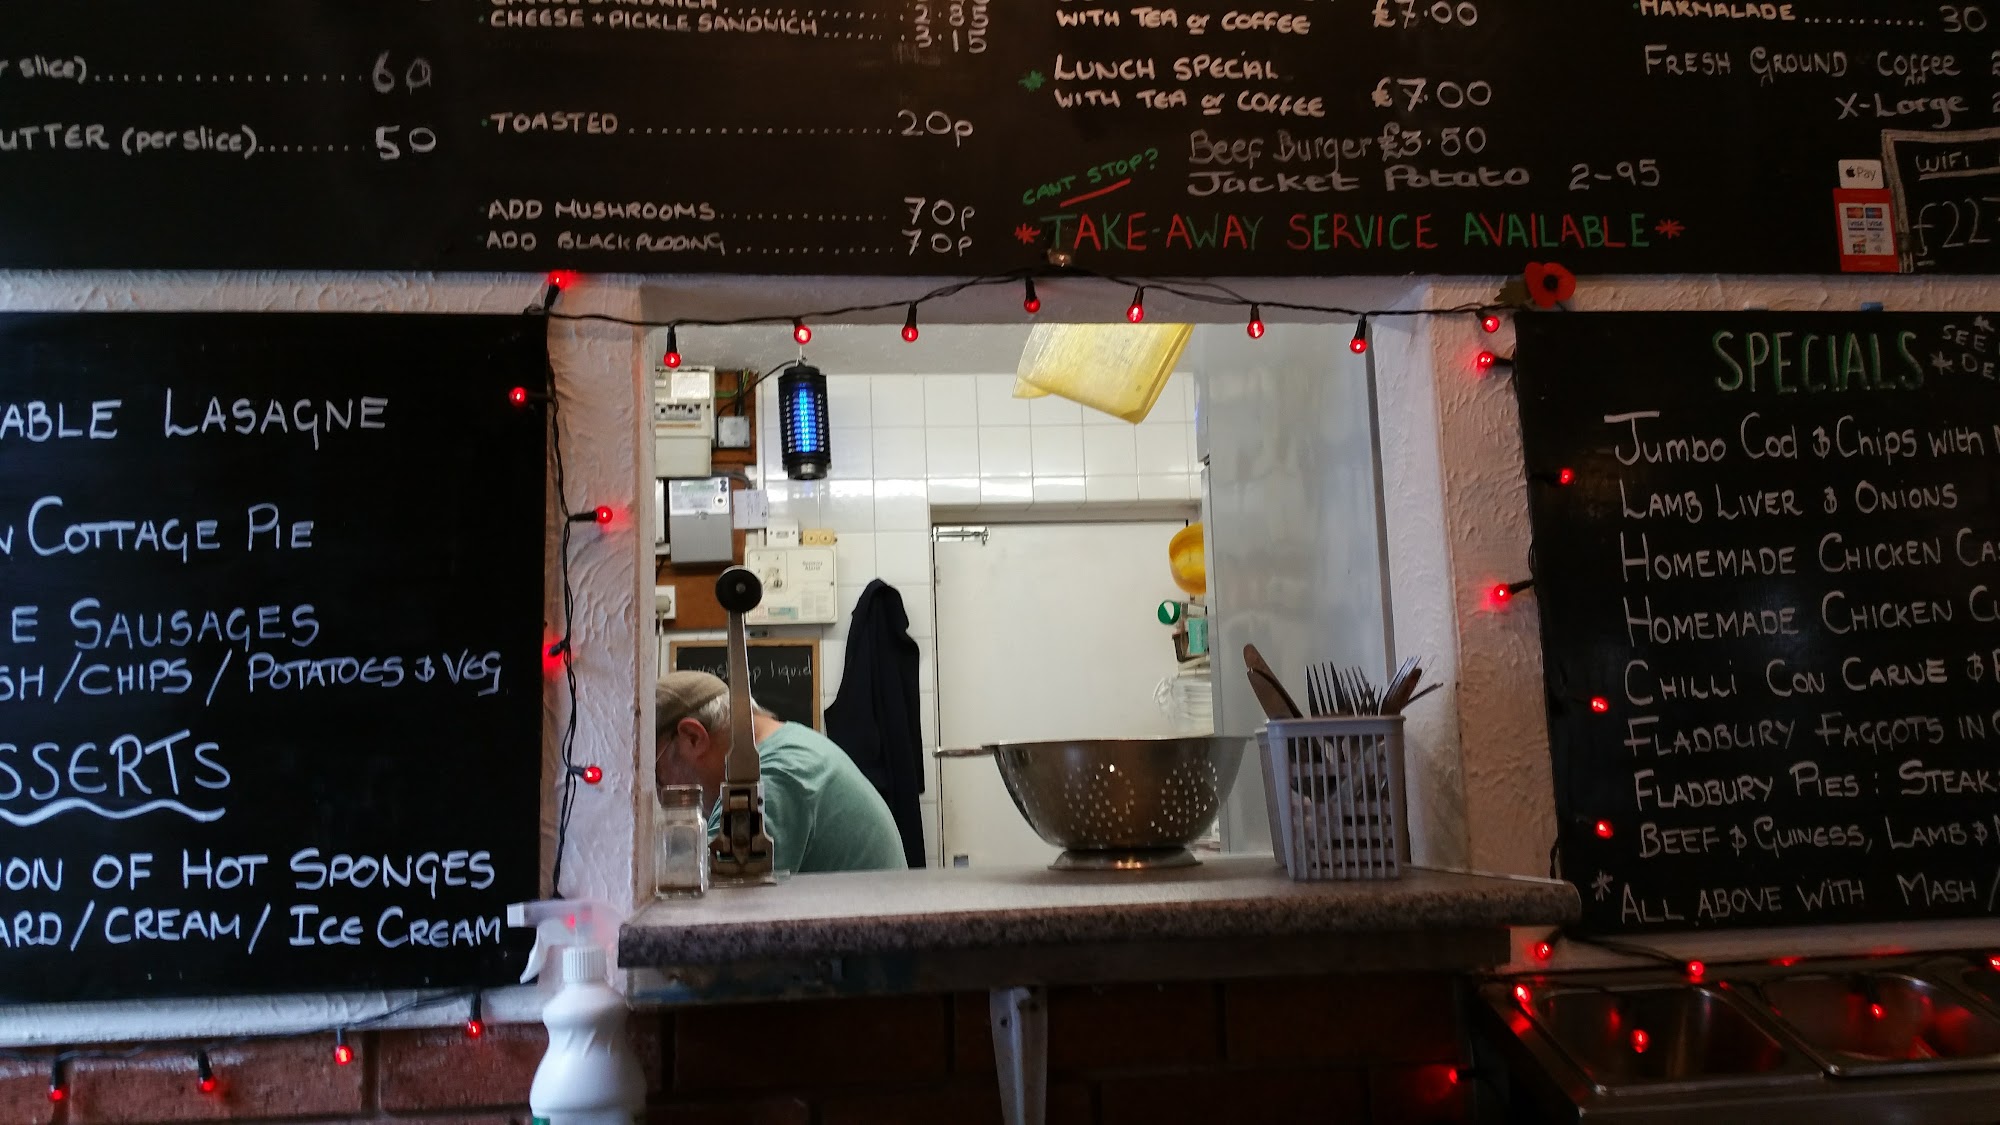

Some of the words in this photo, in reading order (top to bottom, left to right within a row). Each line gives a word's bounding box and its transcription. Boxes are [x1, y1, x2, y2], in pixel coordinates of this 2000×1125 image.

[491, 9, 584, 27] CHEESE
[609, 10, 690, 32] PICKLE
[699, 13, 818, 36] SANDWICH
[1056, 9, 1121, 28] WITH
[1131, 6, 1179, 29] TEA
[1221, 10, 1312, 36] COFFEE
[1640, 0, 1796, 21] MARMALADE
[1939, 6, 1987, 33] 30
[20, 56, 87, 84] slice)
[1055, 54, 1156, 81] LUNCH
[1174, 53, 1279, 81] SPECIAL
[1645, 44, 1731, 76] FRESH
[1751, 47, 1848, 87] GROUND
[1055, 88, 1120, 109] WITH
[1136, 89, 1187, 108] TEA
[1237, 90, 1325, 118] COFFEE
[122, 126, 177, 155] (per
[183, 125, 257, 159] slice)
[491, 112, 619, 135] TOASTED
[898, 110, 974, 147] 20p
[1188, 128, 1265, 169] Beef
[1273, 129, 1373, 175] Burger
[1022, 175, 1077, 206] CANT
[1086, 147, 1159, 184] STOP?
[1187, 170, 1360, 197] Jacket
[1385, 164, 1530, 190] Potato
[487, 200, 543, 220] ADD
[555, 202, 716, 221] MUSHROOMS
[1287, 214, 1437, 250] SERVICE
[1463, 210, 1650, 250] AVAILABLE
[486, 231, 536, 250] ADD
[1712, 331, 1925, 392] SPECIALS
[163, 387, 389, 451] LASAGNE
[1603, 410, 1726, 466] Jumbo
[1619, 478, 1702, 524] LAMB
[1715, 483, 1804, 520] LIVER
[1855, 480, 1958, 514] ONIONS
[27, 495, 221, 564] COTTAGE
[247, 502, 315, 553] PIE
[1620, 531, 1796, 583] HOMEMADE
[1818, 532, 1941, 573] CHICKEN
[70, 598, 320, 652] SAUSAGES
[1623, 595, 1799, 647] HOMEMADE
[1821, 590, 1952, 634] CHICKEN
[247, 652, 404, 693] POTATOES
[1766, 659, 1826, 698] CON
[1842, 656, 1948, 692] CARNE
[1624, 715, 1796, 757] FLADBURY
[1959, 714, 1984, 740] IN
[1634, 769, 1774, 811] FLADBURY
[1640, 823, 1720, 858] BEEF
[1885, 817, 1966, 850] LAMB
[92, 853, 153, 890] OF
[183, 848, 268, 889] HOT
[290, 847, 495, 899] SPONGES
[1622, 882, 1685, 924] ALL
[1696, 884, 1782, 925] ABOVE
[1797, 876, 1864, 912] WITH
[1897, 872, 1976, 906] MASH
[289, 904, 364, 946] ICE
[376, 906, 501, 949] CREAM
